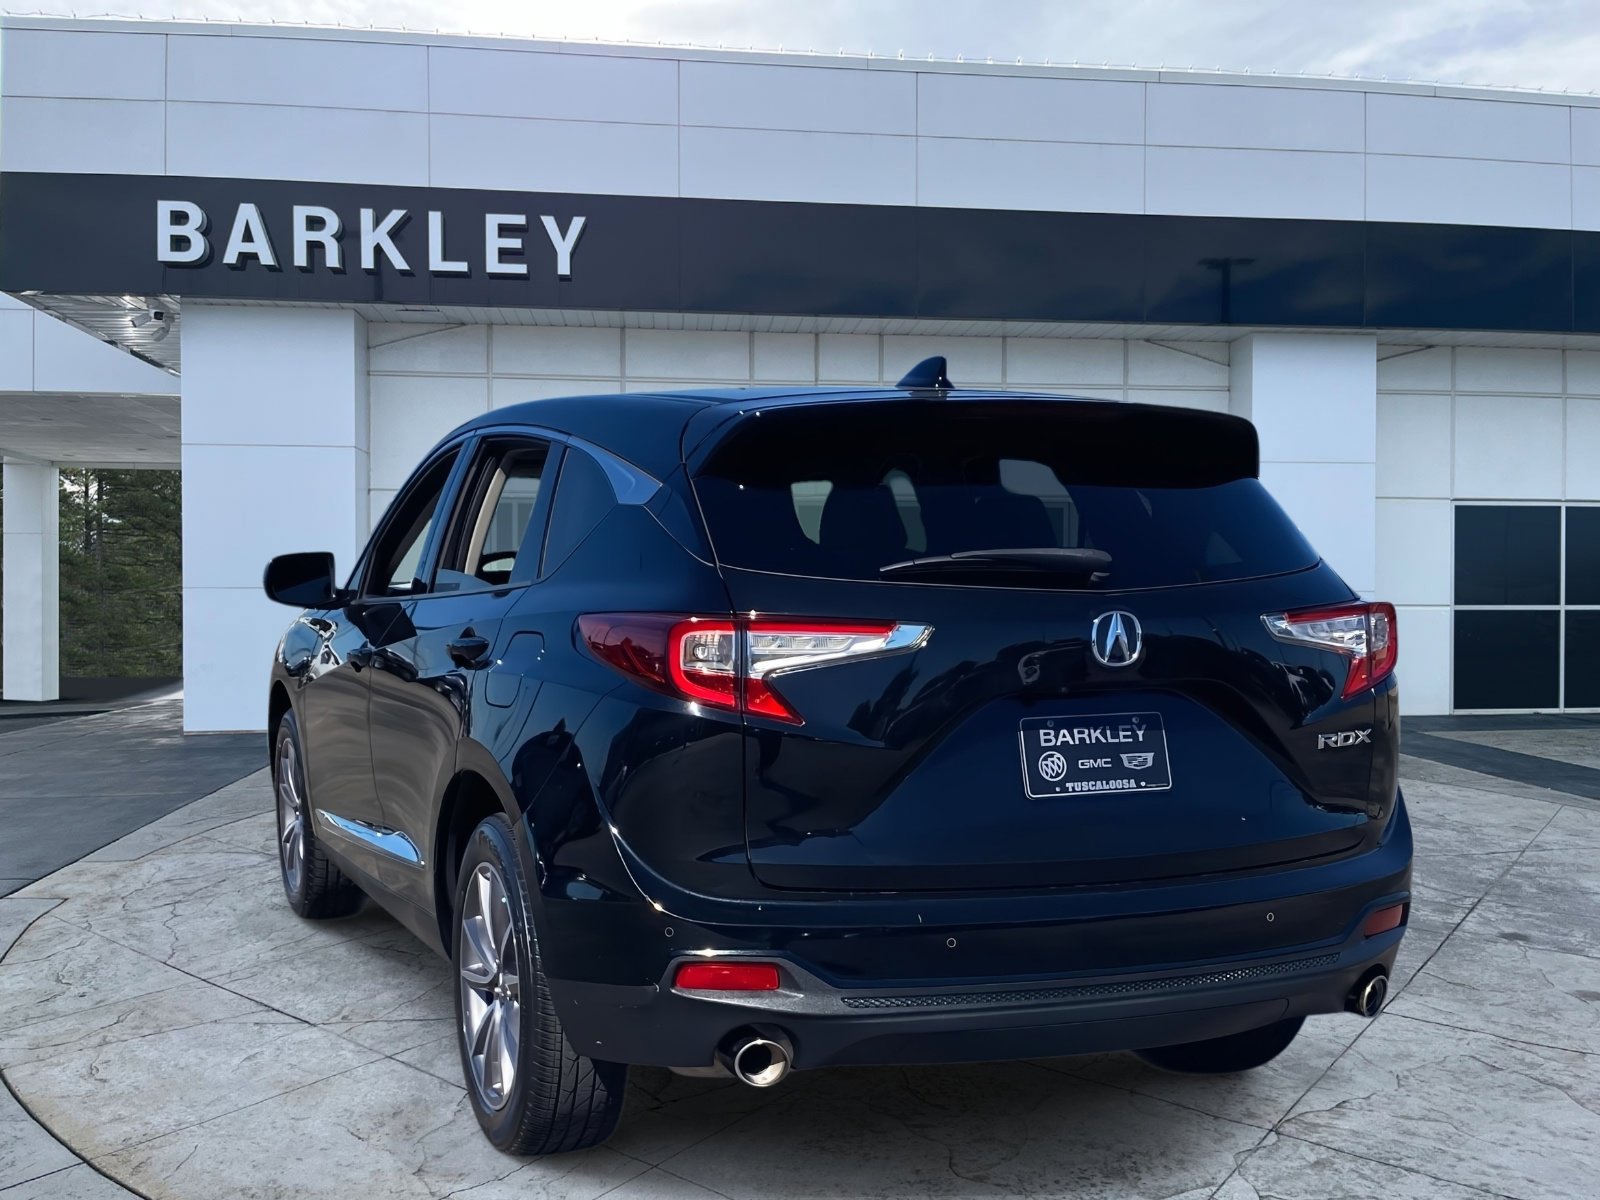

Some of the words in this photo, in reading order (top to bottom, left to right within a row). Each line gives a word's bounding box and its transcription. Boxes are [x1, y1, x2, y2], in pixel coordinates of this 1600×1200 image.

[156, 199, 587, 278] BARKLEY
[1039, 724, 1147, 747] BARKLEY
[1317, 728, 1372, 750] RDX
[1078, 758, 1113, 769] GMC
[1065, 778, 1137, 793] TUSCALOOSA
